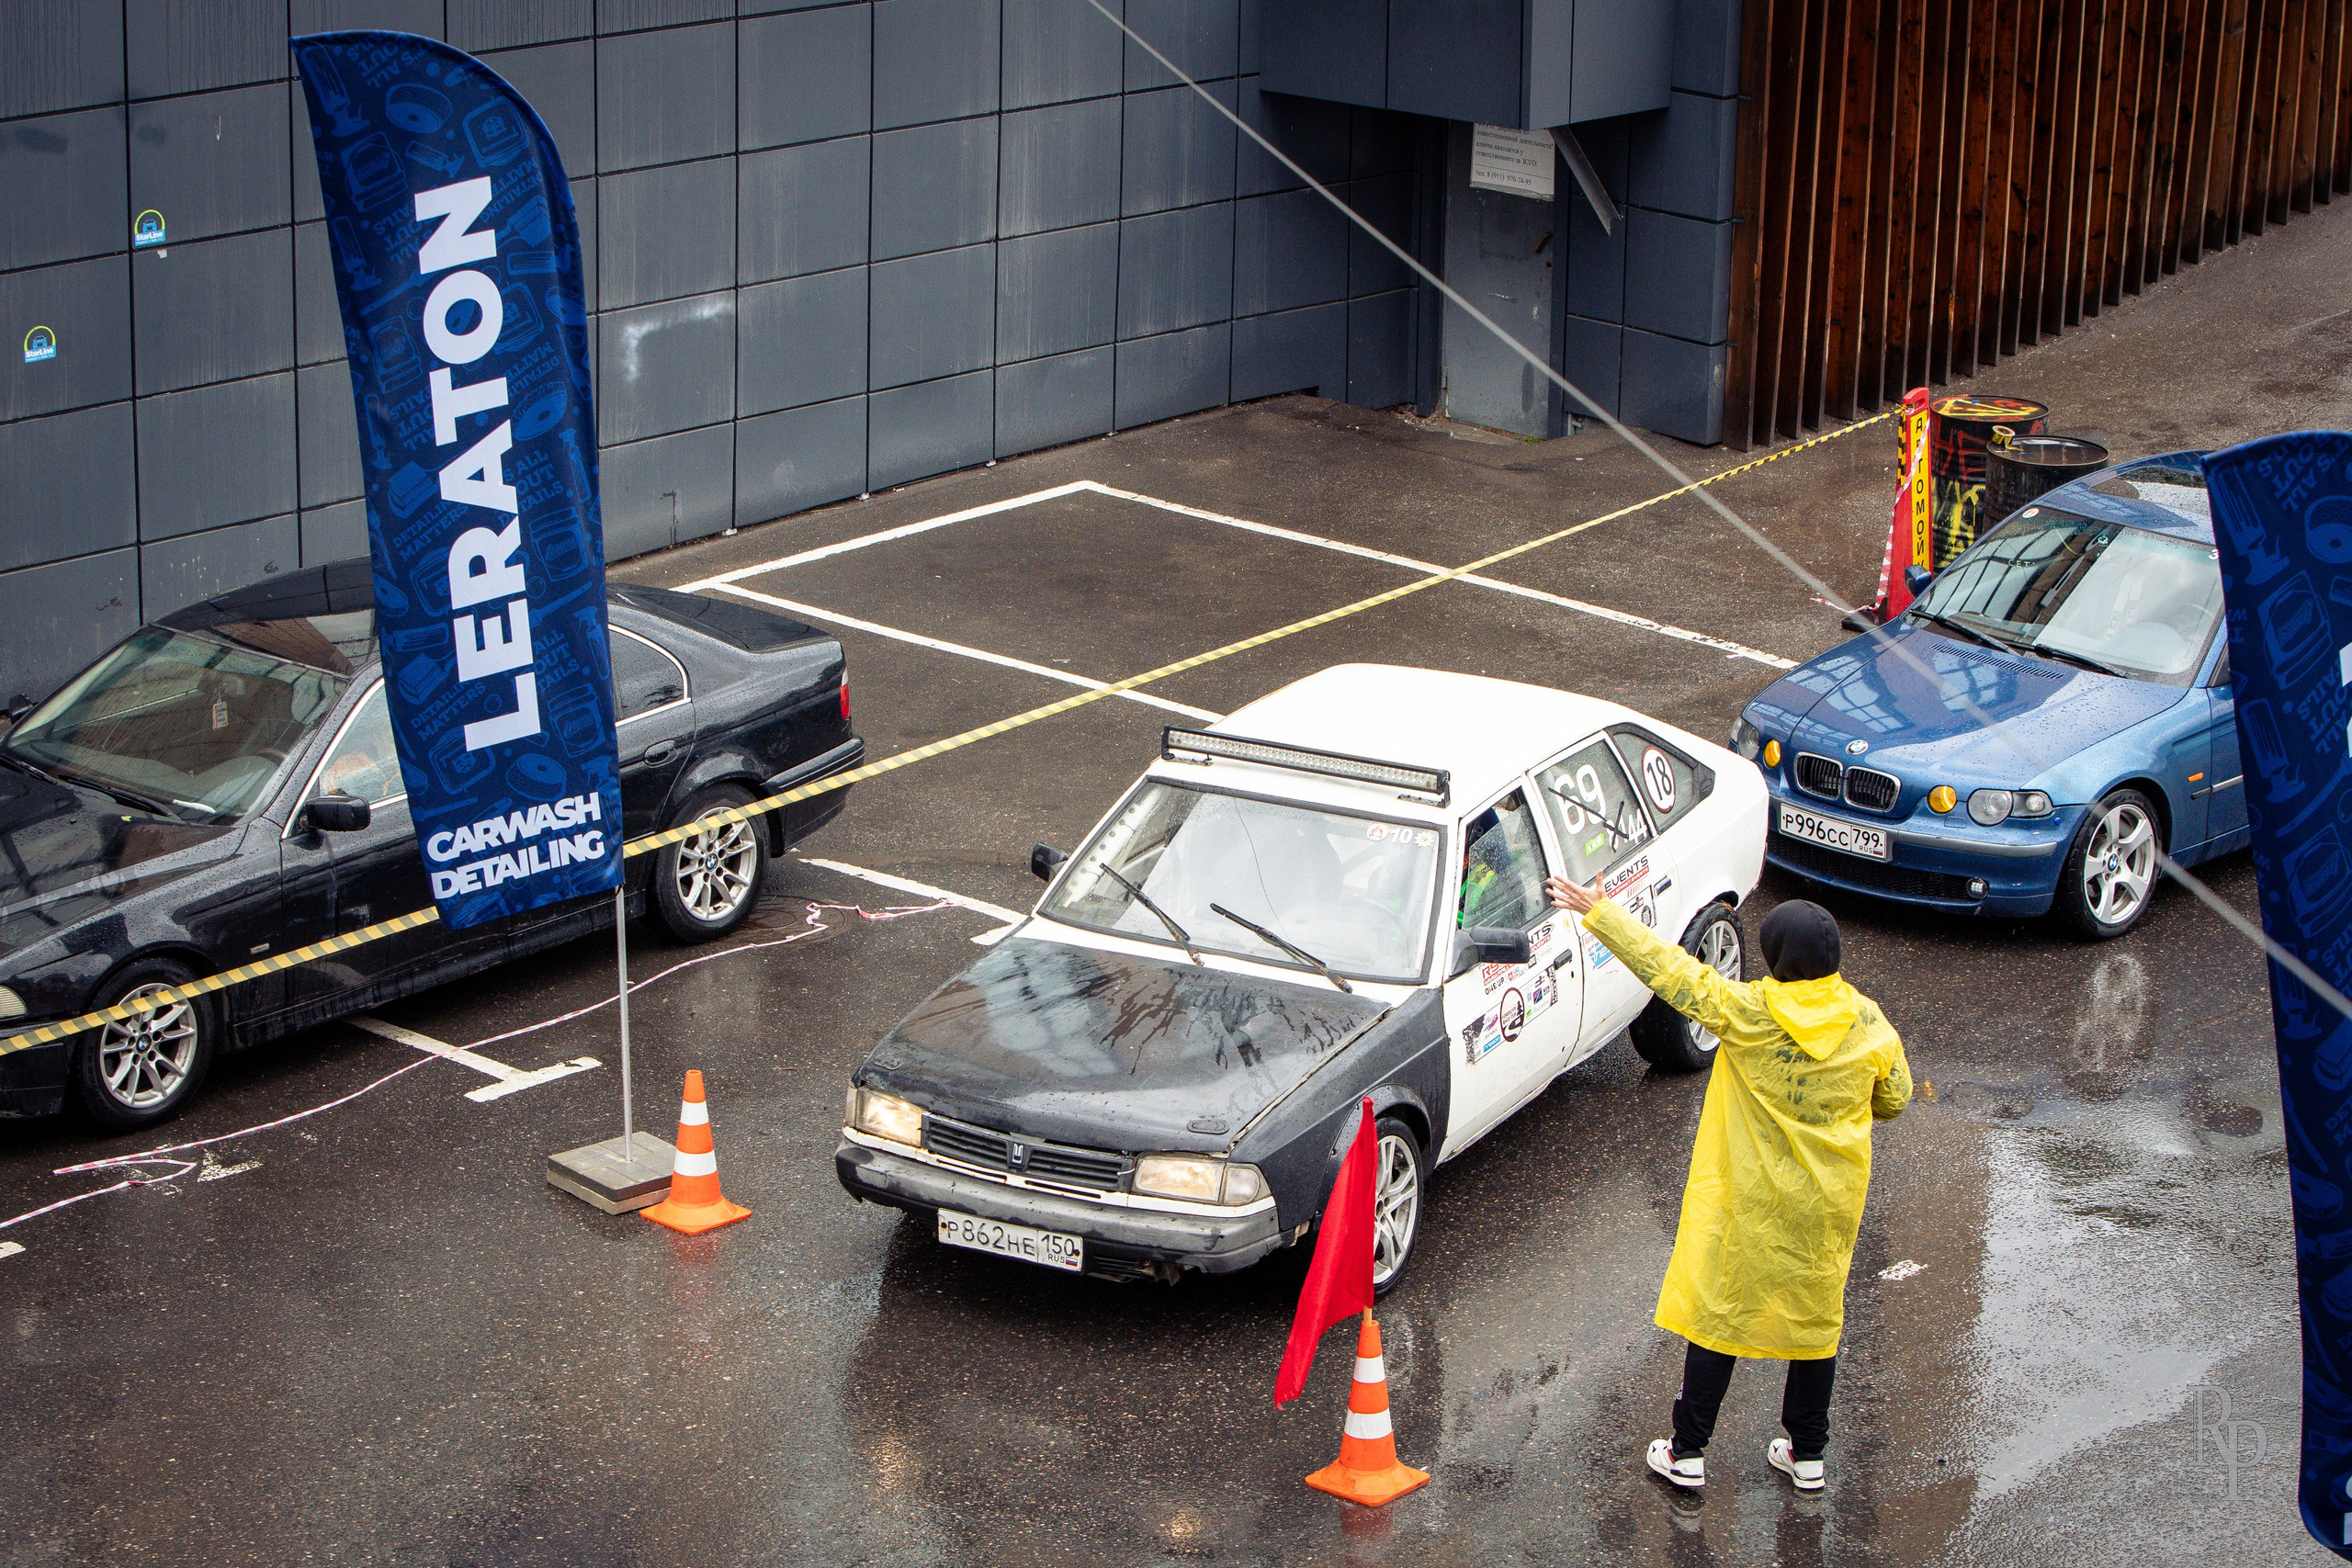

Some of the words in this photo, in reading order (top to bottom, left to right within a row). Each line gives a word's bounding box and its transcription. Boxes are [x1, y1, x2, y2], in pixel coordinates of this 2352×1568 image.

[367, 60, 401, 88] ALL
[480, 172, 543, 223] DETAILING
[136, 231, 163, 242] StarLine
[26, 347, 54, 358] StarLine
[414, 175, 540, 752] LERATON
[515, 450, 548, 475] ALL
[2281, 468, 2317, 511] ALL
[400, 502, 469, 562] MATTERS
[534, 630, 565, 655] ALL
[418, 682, 486, 741] MATTERS
[2315, 708, 2348, 753] ALL
[1646, 756, 1672, 802] 18
[1553, 763, 1607, 836] 69
[426, 791, 602, 863] CARWASH
[1391, 828, 1413, 844] 10
[1852, 828, 1880, 848] 799
[430, 829, 605, 900] DETAILING
[1859, 845, 1873, 853] RUS
[1604, 855, 1648, 893] EVENTS
[1041, 1234, 1075, 1257] 150
[1047, 1253, 1066, 1264] RUS
